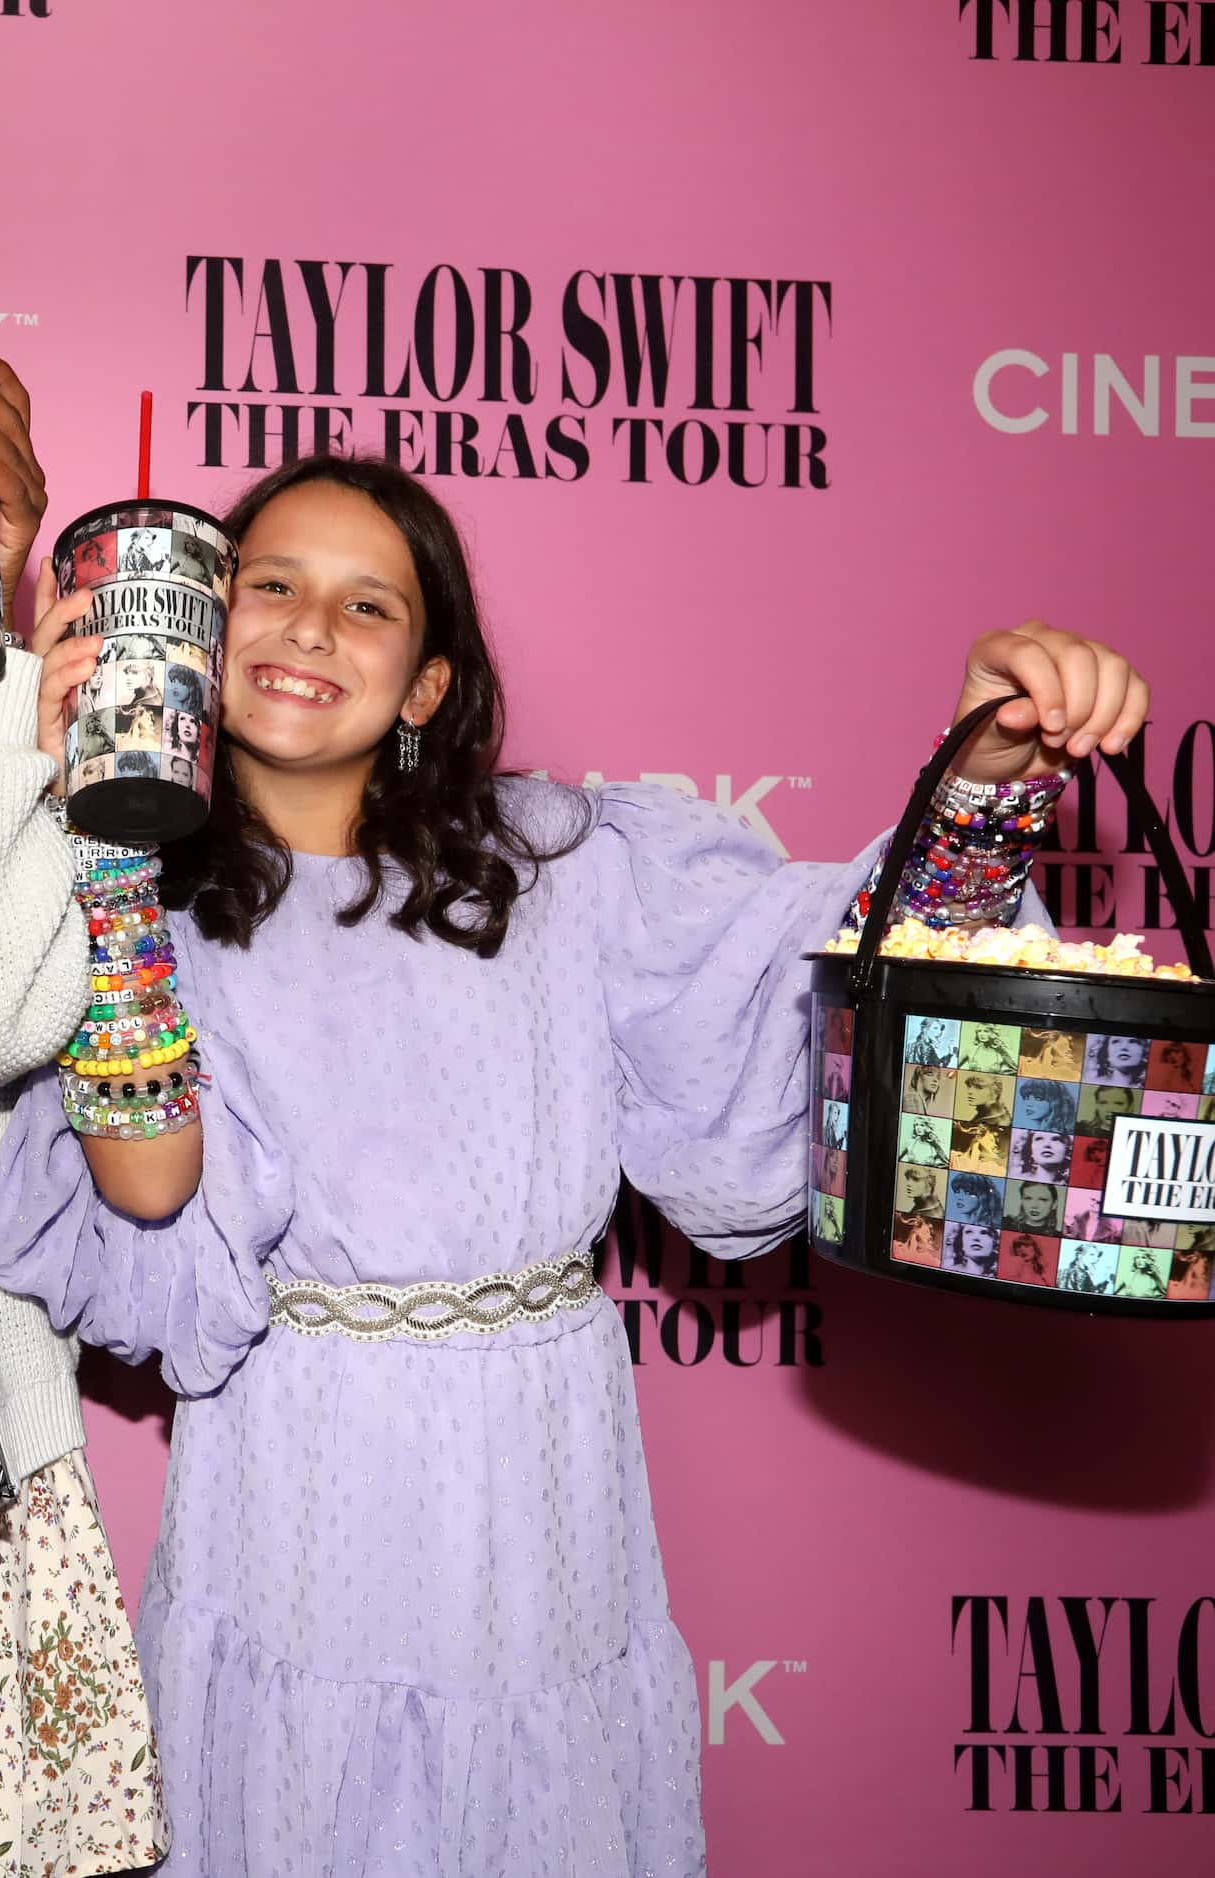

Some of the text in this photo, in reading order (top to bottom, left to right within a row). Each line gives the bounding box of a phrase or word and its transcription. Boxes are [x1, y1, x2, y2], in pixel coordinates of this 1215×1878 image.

[186, 255, 833, 414] TAYLOR SWIFT
[187, 402, 832, 490] THE ERAS TOUR
[113, 613, 160, 629] ERAS
[165, 615, 206, 642] TOUR
[153, 586, 209, 627] SWIFT
[95, 1019, 142, 1032] WELL
[1120, 1180, 1183, 1208] THE
[614, 1298, 827, 1368] TOUR
[954, 1744, 1122, 1812] THE
